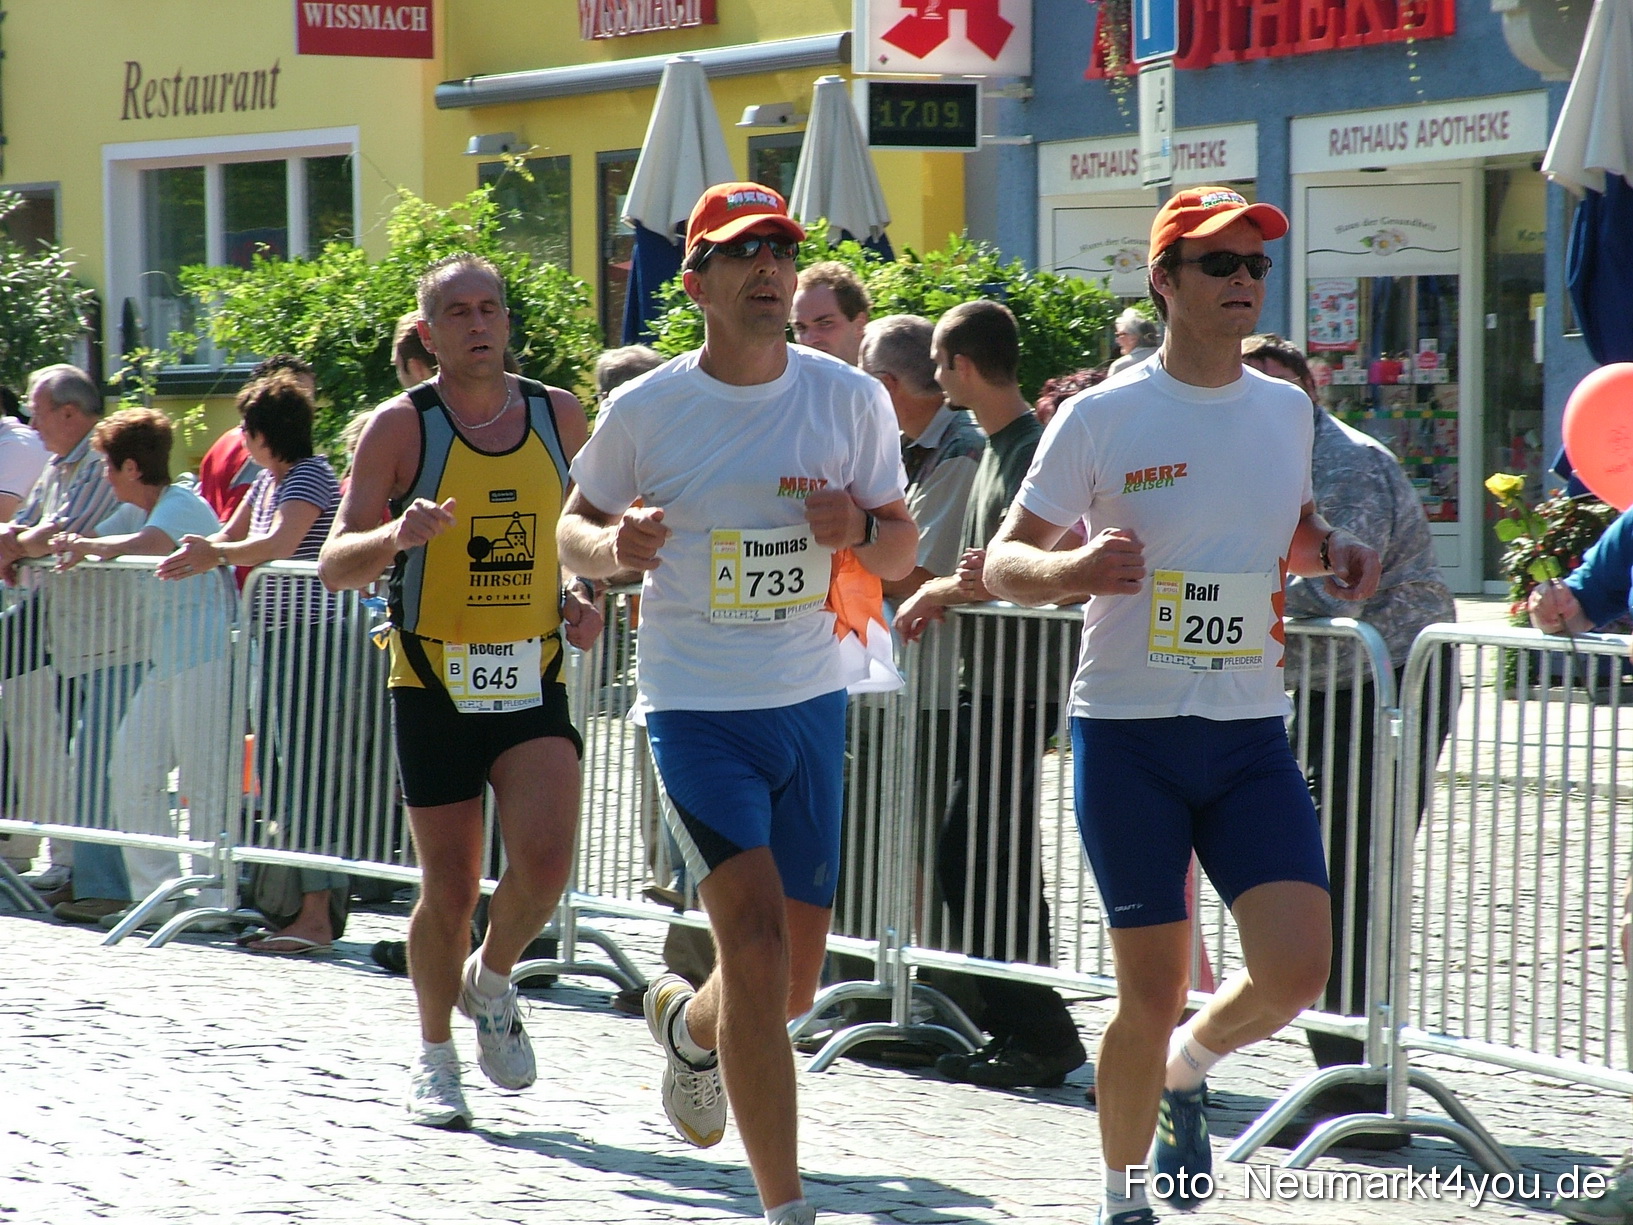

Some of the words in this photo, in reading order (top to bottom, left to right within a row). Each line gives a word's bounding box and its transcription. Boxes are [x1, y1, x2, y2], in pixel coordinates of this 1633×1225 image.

[303, 2, 428, 32] WISSMACH
[120, 57, 282, 121] Restaurant
[1329, 120, 1410, 157] RATHAUS
[1416, 110, 1511, 149] APOTHEKE
[1070, 148, 1140, 181] RATHAUS
[1125, 462, 1188, 485] MERZ
[1122, 476, 1175, 494] Reisen
[743, 537, 808, 558] Thomas
[469, 573, 532, 587] HIRSCH
[718, 566, 732, 580] A
[746, 567, 805, 598] 733
[1184, 582, 1220, 601] Ralf
[1159, 606, 1172, 621] B
[1183, 615, 1244, 645] 205
[450, 663, 461, 675] B
[1150, 652, 1197, 666] BOCK
[1224, 655, 1263, 666] PFLEIDERER
[472, 667, 519, 690] 645
